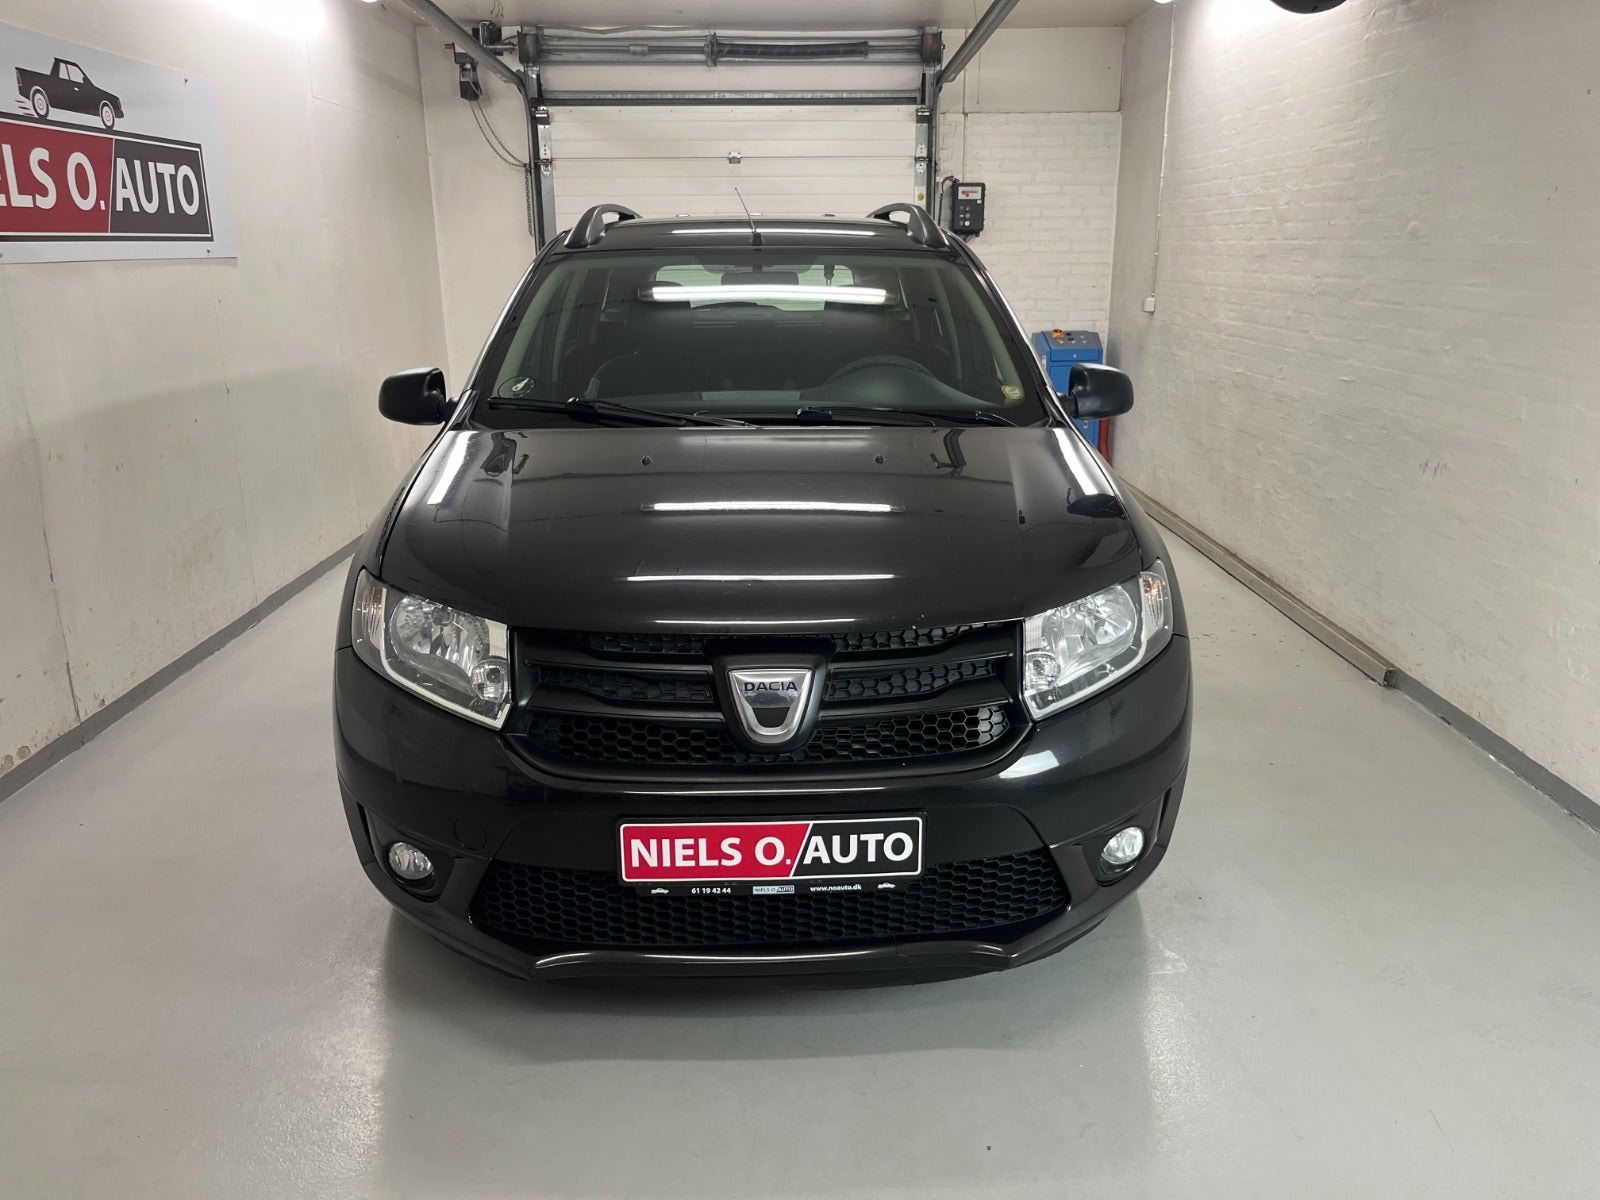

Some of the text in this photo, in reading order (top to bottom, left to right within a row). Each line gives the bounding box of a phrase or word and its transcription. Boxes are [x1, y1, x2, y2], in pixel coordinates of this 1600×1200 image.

[0, 143, 200, 216] LS O. AUTO
[744, 681, 798, 692] DACIA
[630, 832, 914, 868] NIELS O. AUTO
[810, 884, 862, 892] www.noauto.dk
